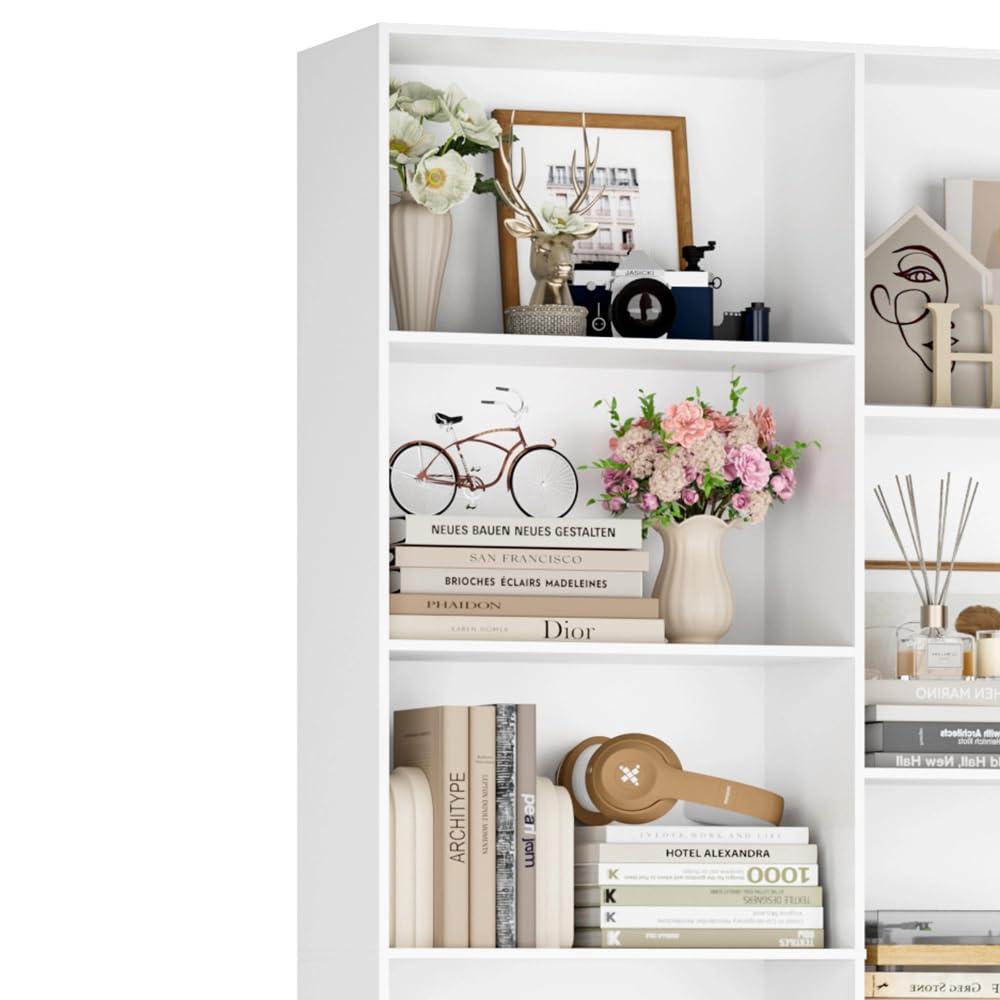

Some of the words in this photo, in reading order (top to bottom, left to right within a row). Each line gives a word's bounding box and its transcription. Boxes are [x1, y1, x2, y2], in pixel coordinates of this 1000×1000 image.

[432, 525, 468, 535] NEUES
[473, 525, 510, 535] BAUEN
[515, 526, 551, 536] NEUES
[555, 527, 615, 537] GESTALTEN
[470, 553, 495, 563] SAN
[503, 554, 582, 565] FRANCISCO
[445, 577, 495, 586] BRIOCHES
[501, 576, 541, 587] ÉCLAIRS
[546, 579, 607, 588] MADELEINES
[428, 601, 500, 609] PHAIDON
[545, 620, 594, 639] Dior
[449, 773, 465, 863] ARCHITYPE
[666, 849, 701, 857] HOTEL
[704, 849, 770, 857] ALEXANDRA
[747, 866, 809, 883] 1000
